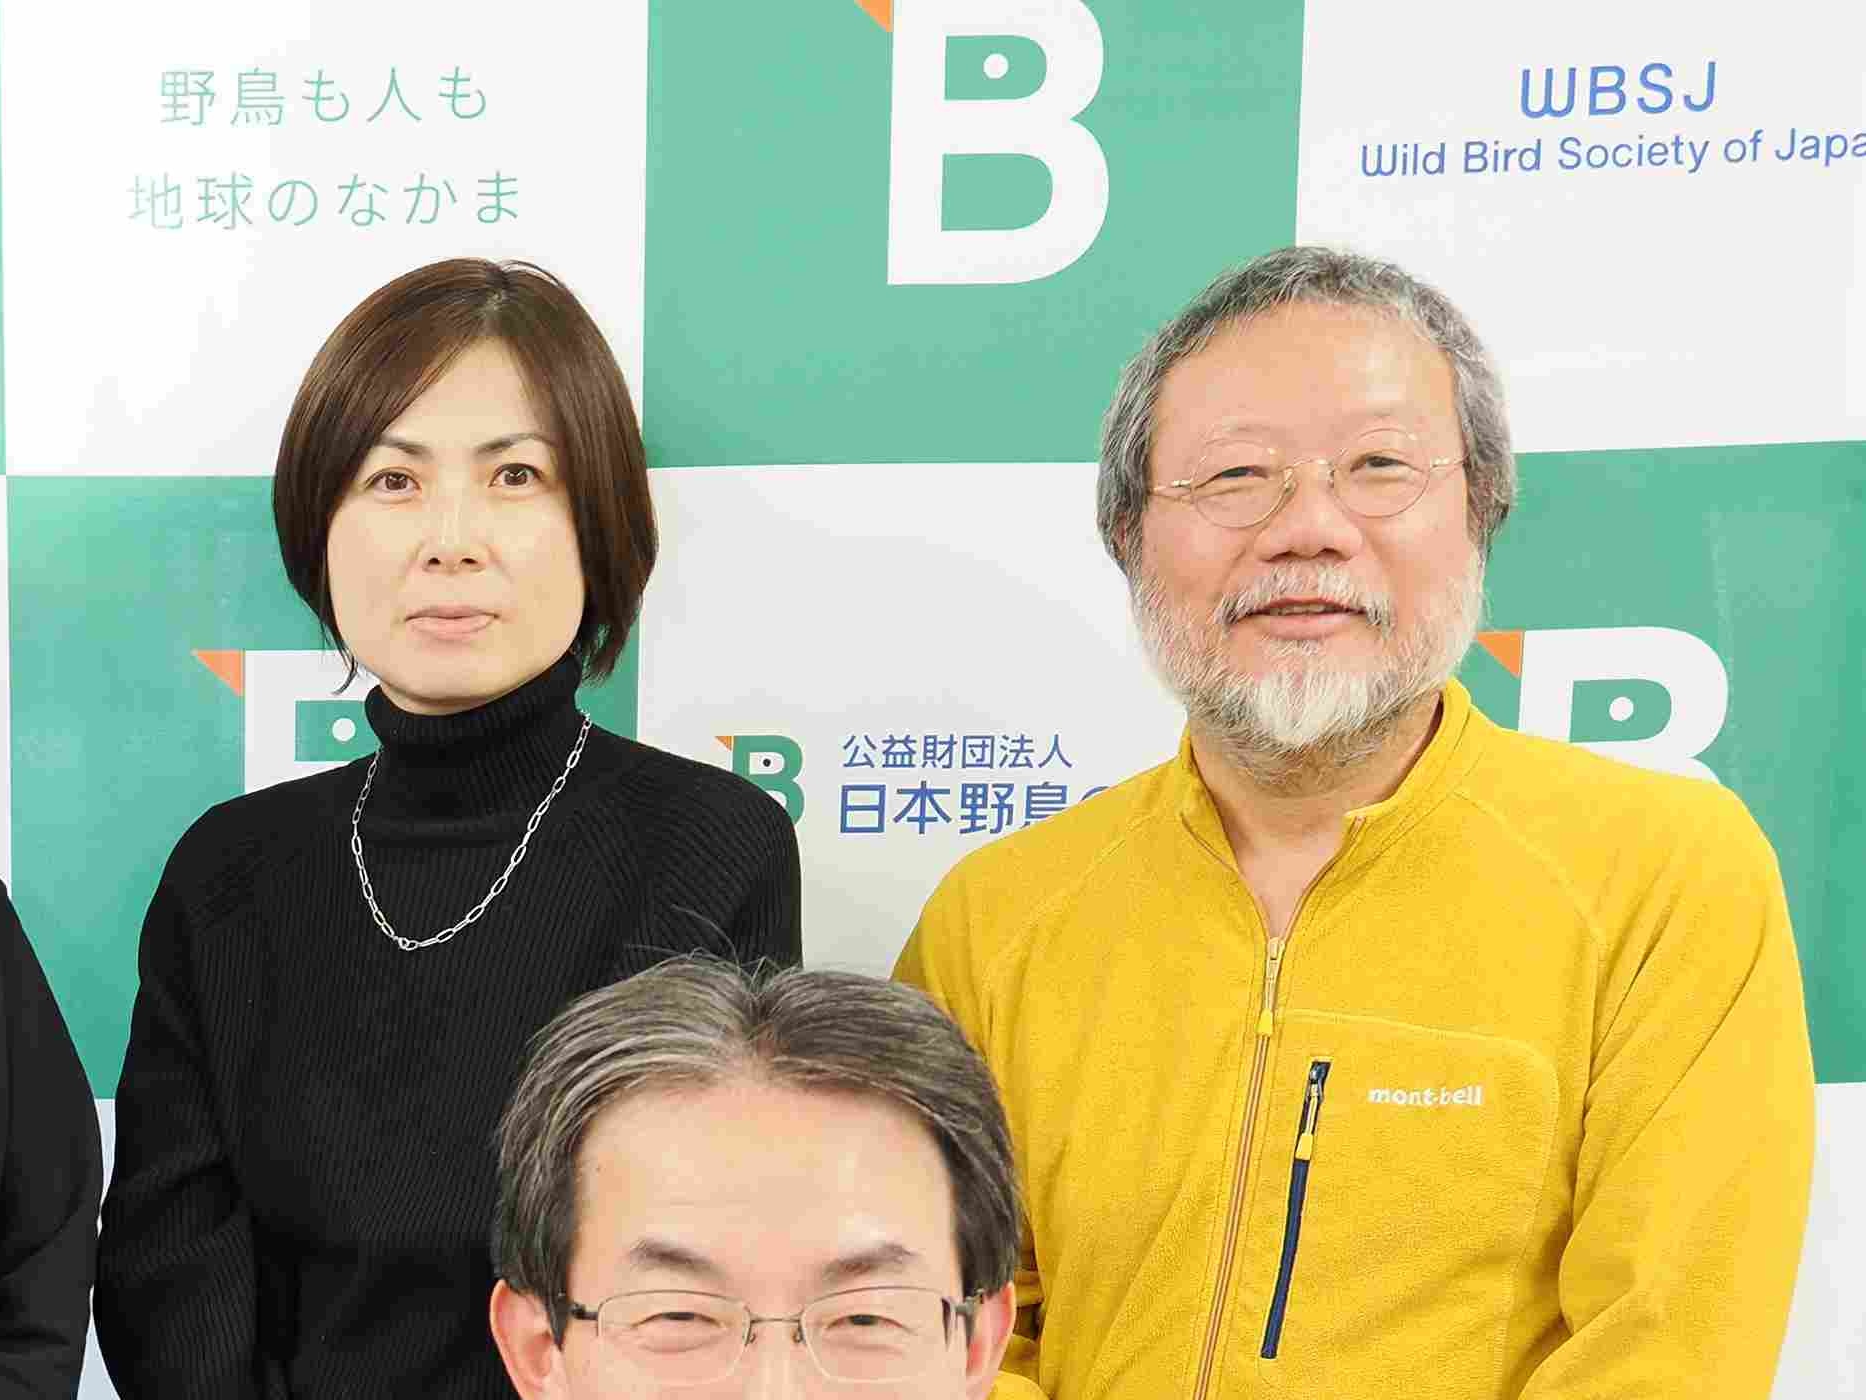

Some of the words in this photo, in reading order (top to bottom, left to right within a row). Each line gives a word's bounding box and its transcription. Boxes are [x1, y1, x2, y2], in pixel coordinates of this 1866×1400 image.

[159, 65, 487, 127] 野鳥も人も
[1518, 60, 1717, 119] WBSJ
[887, 0, 1110, 285] B
[1360, 142, 1446, 177] Wild
[1463, 138, 1542, 174] Bird
[1557, 134, 1711, 174] Society
[1723, 128, 1764, 164] of
[126, 169, 520, 230] 地球のなかま
[842, 734, 1073, 769] 公益財団法人
[839, 780, 1114, 835] 日本野鳥
